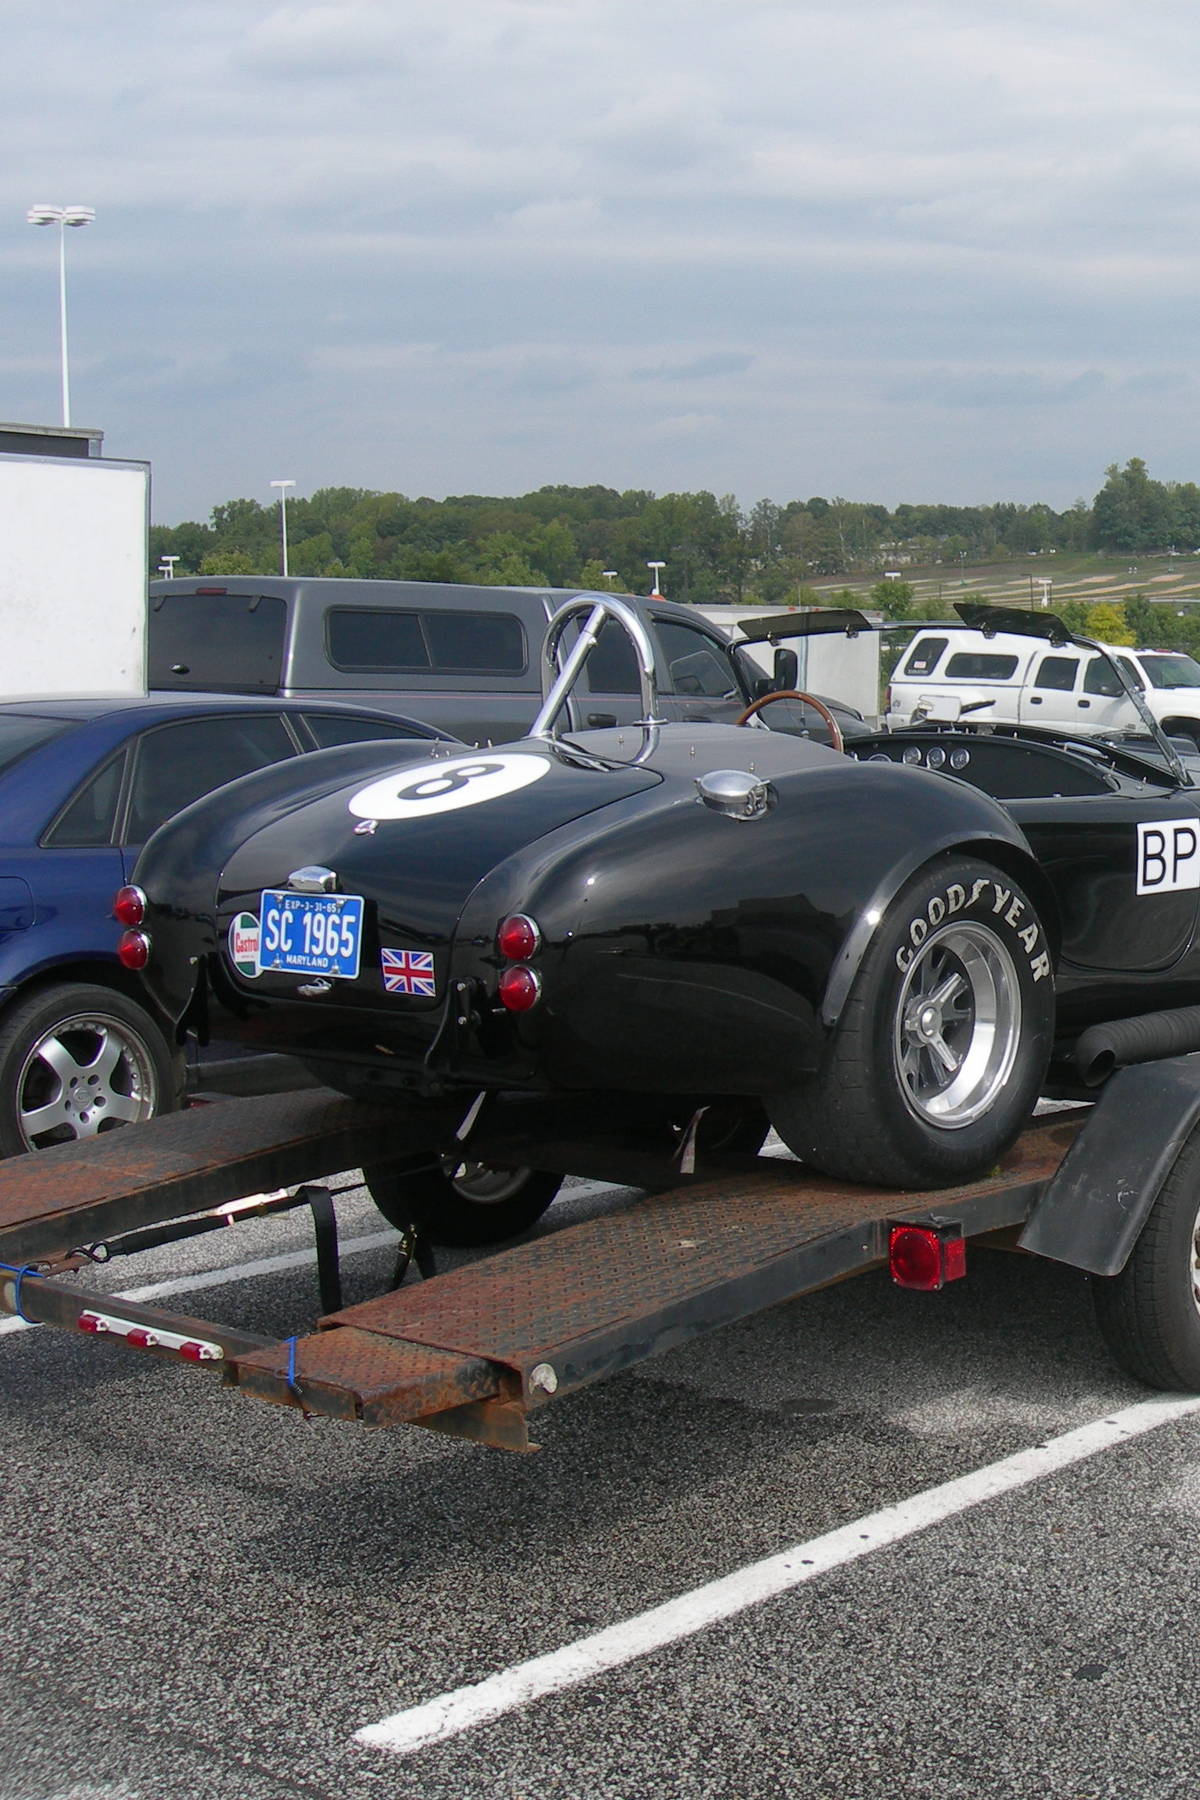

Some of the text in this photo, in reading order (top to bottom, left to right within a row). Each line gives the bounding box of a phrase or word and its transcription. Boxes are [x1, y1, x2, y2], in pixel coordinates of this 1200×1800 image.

[396, 763, 505, 800] 8
[1142, 827, 1197, 886] BP
[265, 909, 357, 958] SC 1965
[895, 878, 1052, 983] GOODYEAR
[286, 954, 329, 968] MARYLAND
